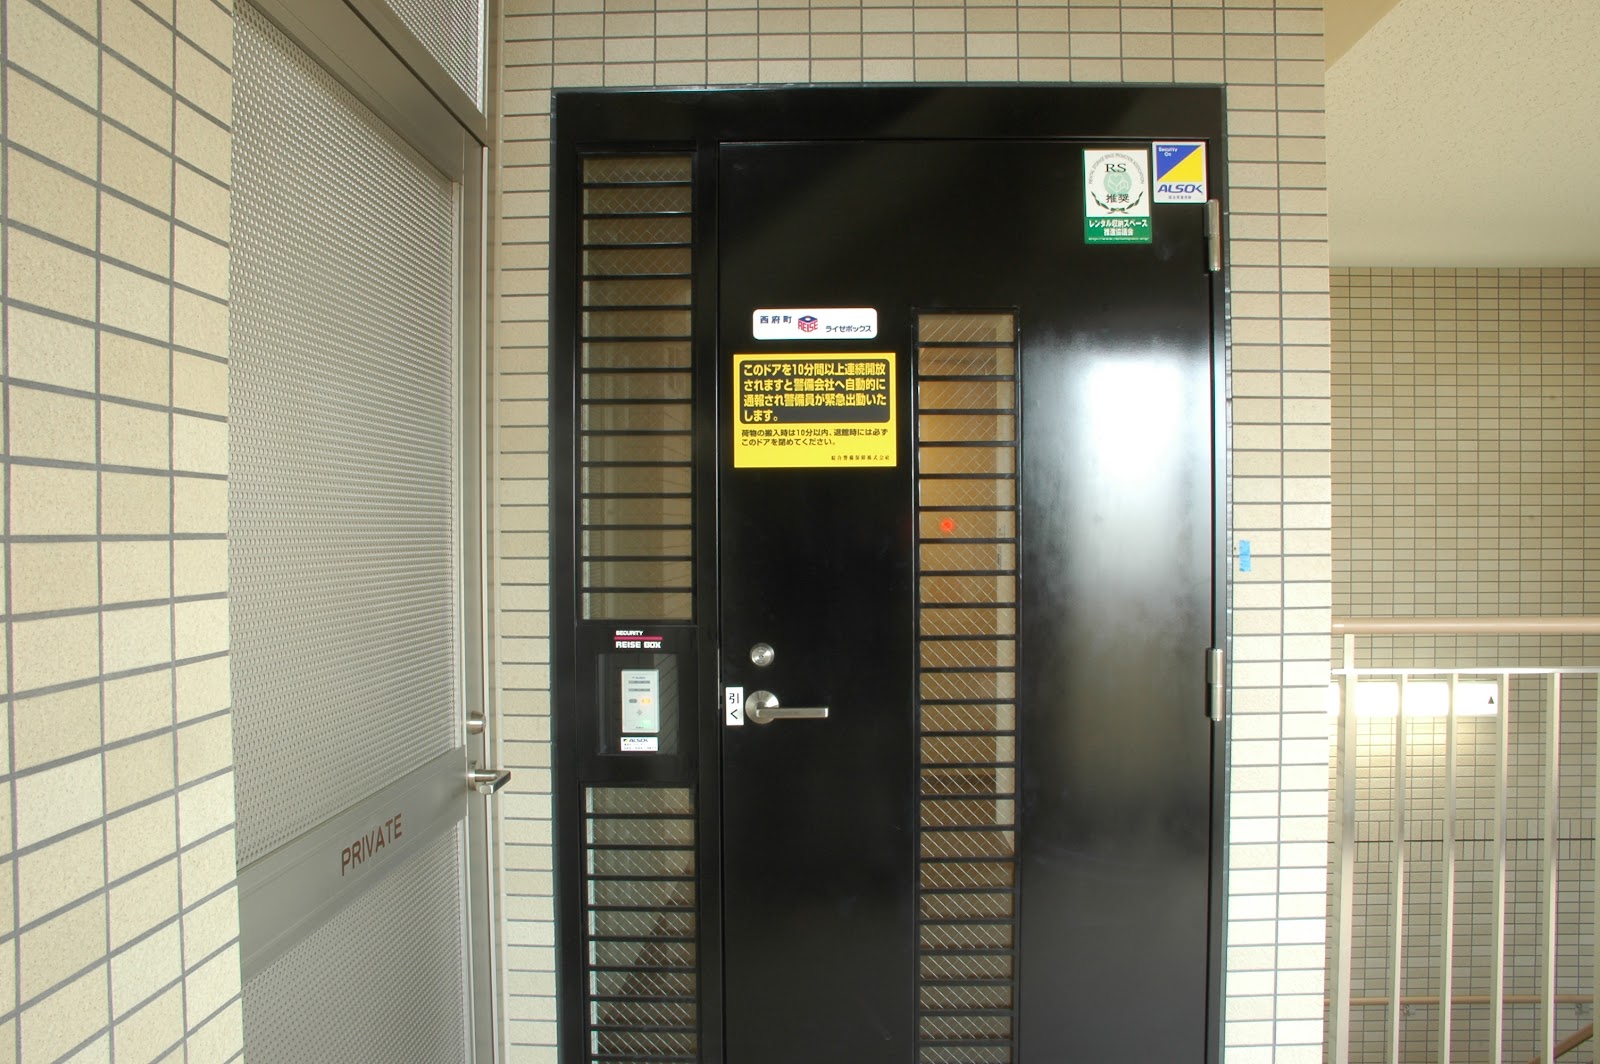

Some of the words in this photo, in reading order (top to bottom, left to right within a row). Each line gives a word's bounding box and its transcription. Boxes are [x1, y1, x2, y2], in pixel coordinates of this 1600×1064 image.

[1105, 163, 1127, 172] RS
[1158, 184, 1203, 193] ALSOK
[1106, 194, 1129, 203] 推奨
[1089, 219, 1148, 228] レンタル収納スペース
[760, 315, 792, 324] 西府町
[798, 320, 818, 333] REISE
[825, 325, 872, 333] ライゼボックス
[743, 362, 886, 376] このドアを10分間以上連続開放
[743, 378, 886, 391] されますと警備会社へ自動的に
[743, 393, 887, 407] 通報され警備員が緊急出動いた
[744, 409, 778, 422] します。
[741, 438, 836, 446] このドアを閉めてください。
[729, 692, 740, 720] 引く
[341, 813, 402, 877] PRIVATE
